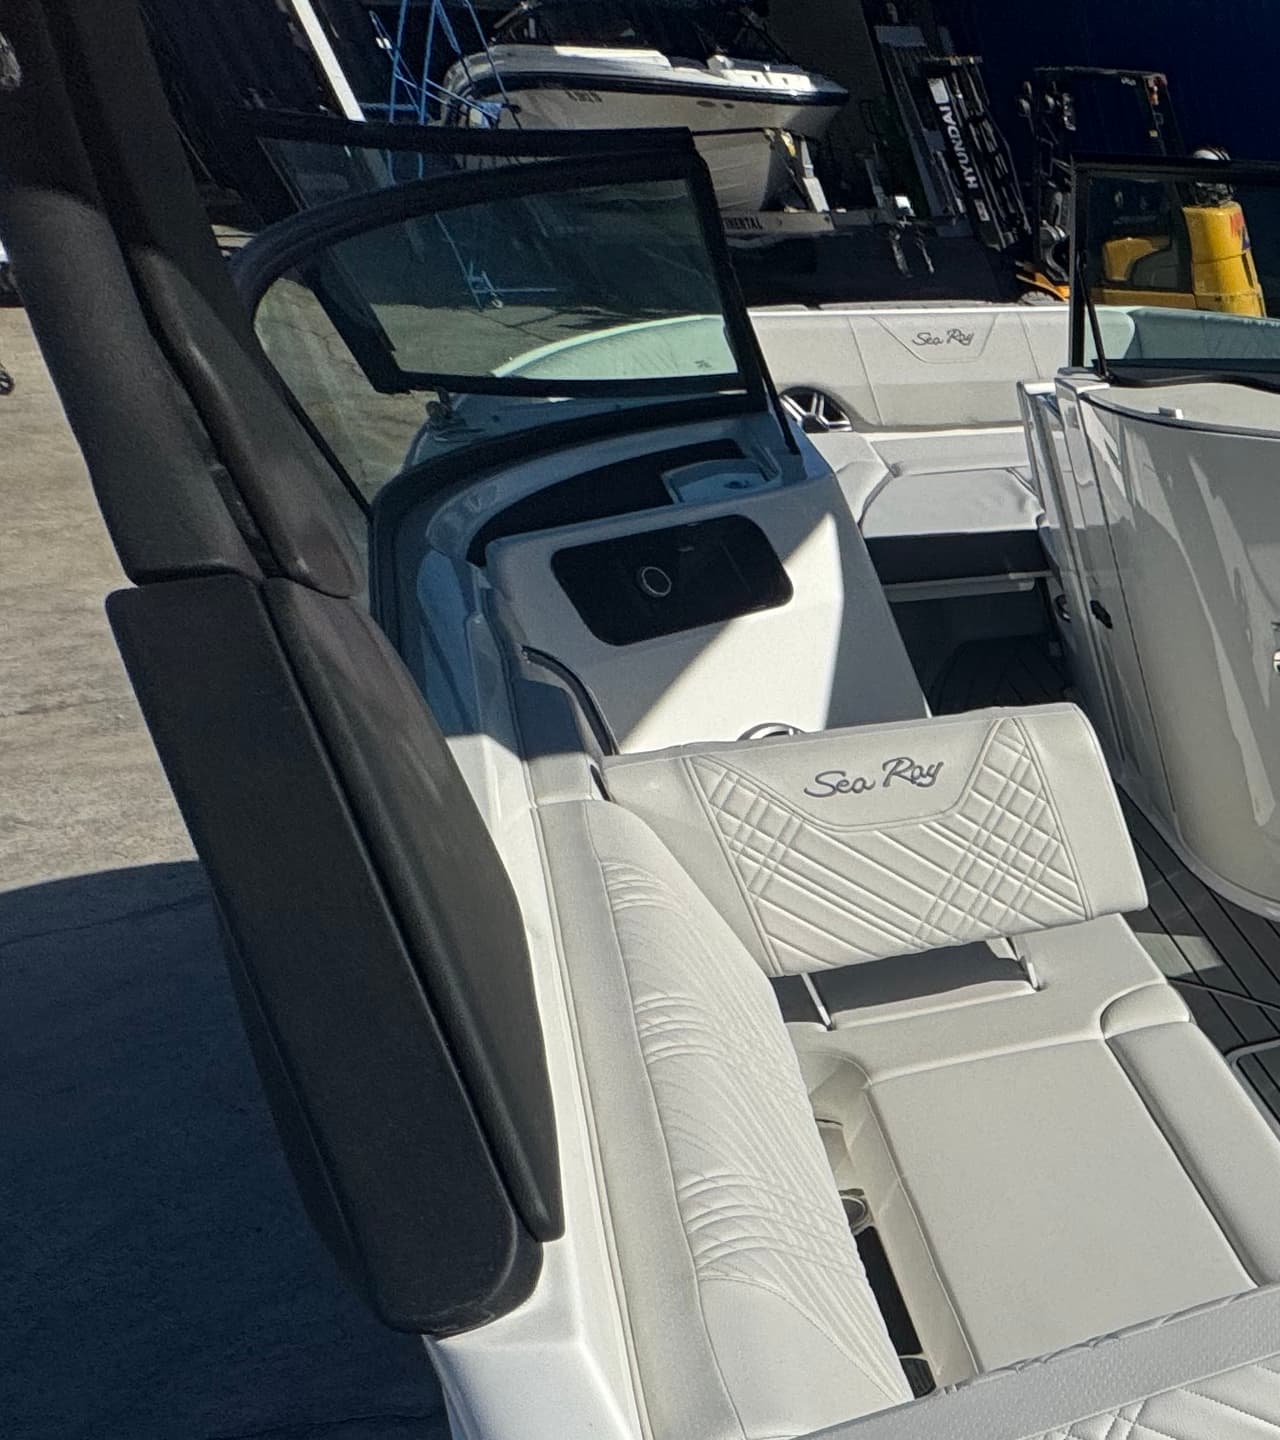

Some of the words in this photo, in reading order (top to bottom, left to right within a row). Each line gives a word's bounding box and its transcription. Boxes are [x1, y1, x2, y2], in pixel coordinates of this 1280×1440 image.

[938, 105, 979, 189] HYUNDAI
[911, 331, 944, 346] Sea
[946, 328, 975, 347] Ray
[804, 770, 876, 798] Sea
[881, 756, 944, 788] Ray
